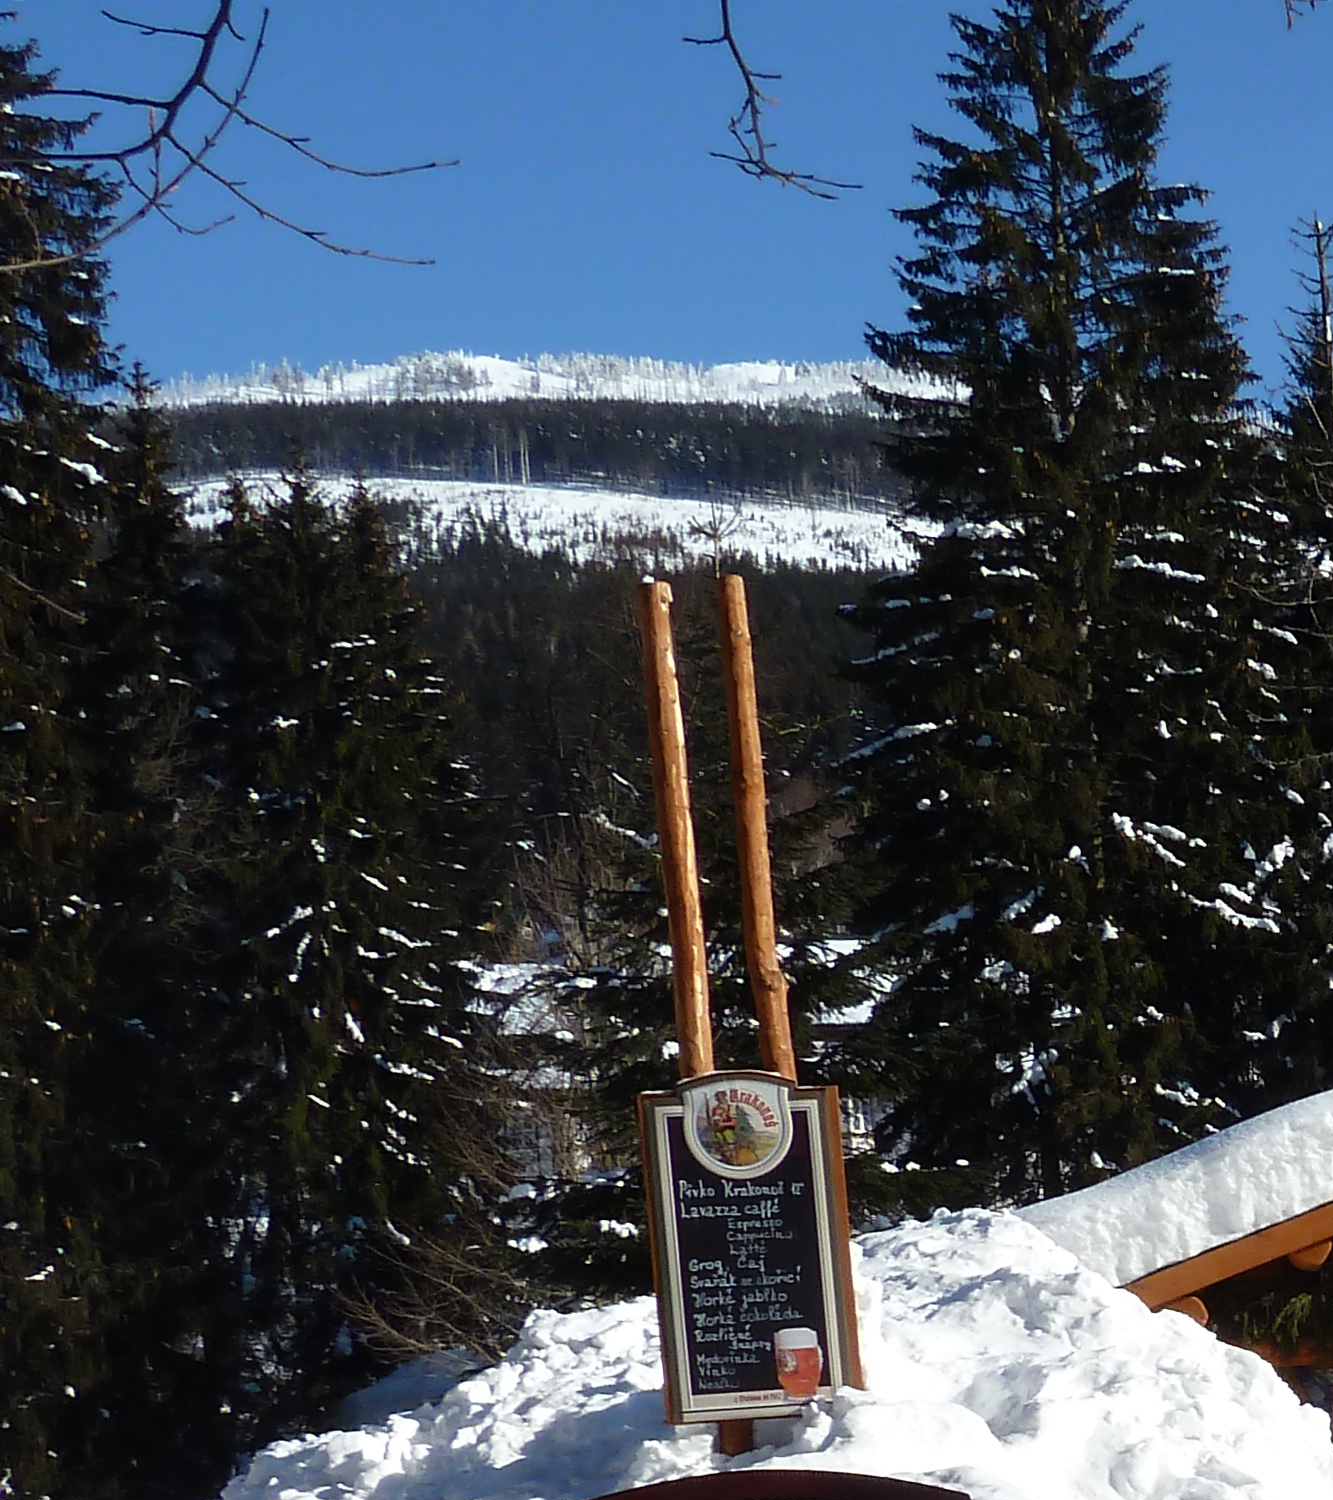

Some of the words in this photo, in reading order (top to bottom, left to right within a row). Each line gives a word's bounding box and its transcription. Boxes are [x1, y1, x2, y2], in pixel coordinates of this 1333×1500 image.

[679, 1179, 716, 1199] Pivko
[680, 1202, 742, 1219] Lavazza
[727, 1217, 783, 1231] Espresso
